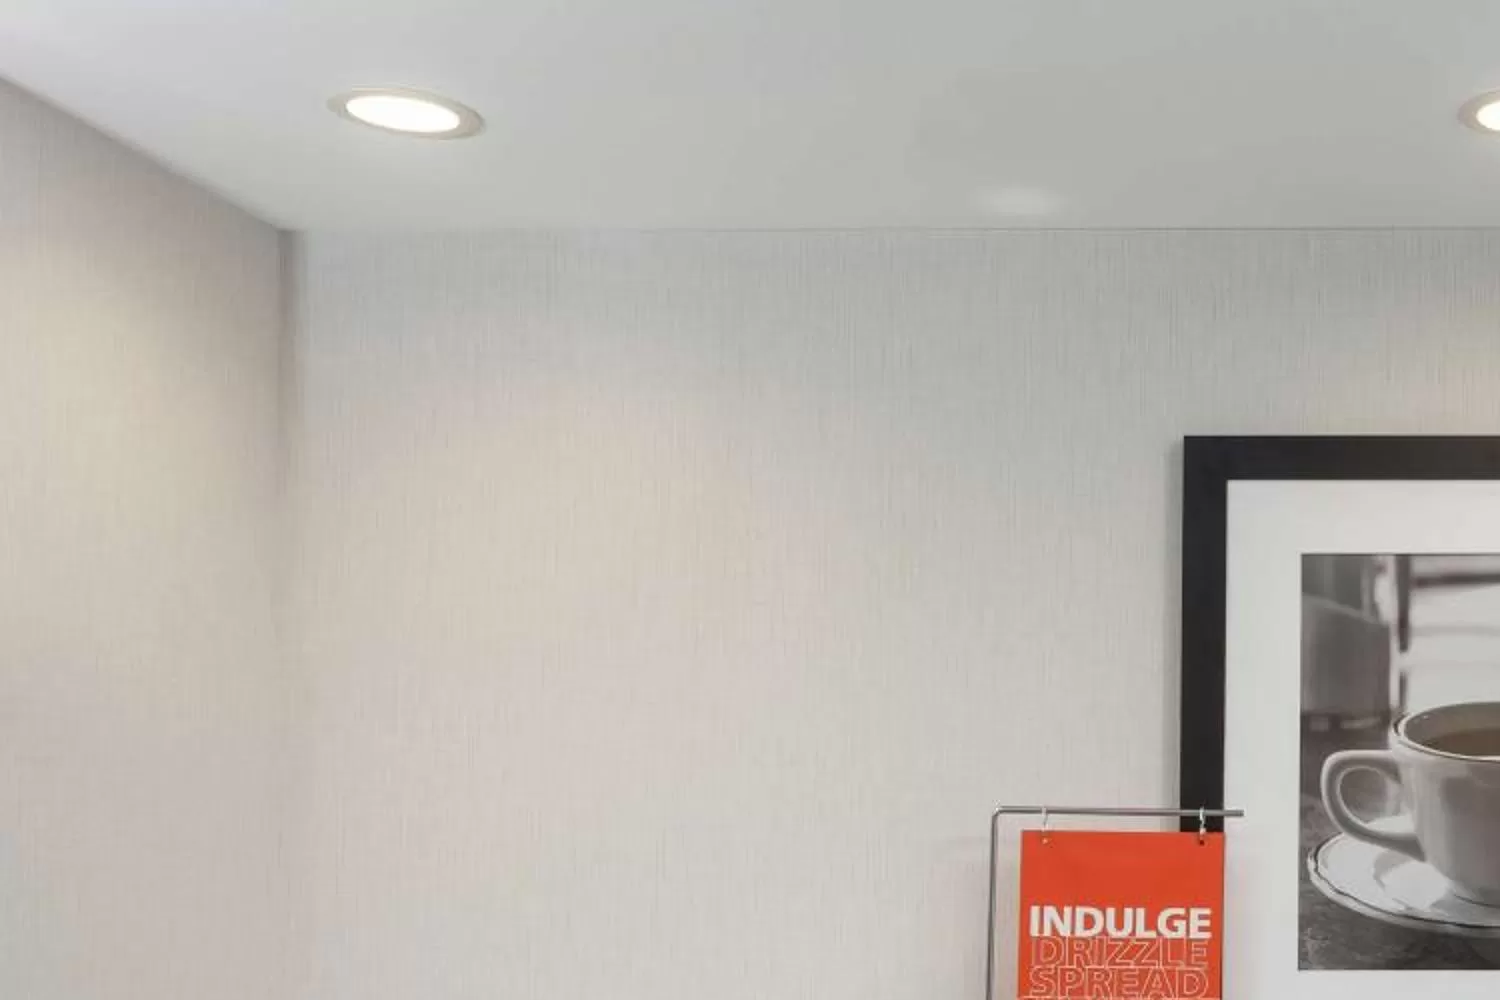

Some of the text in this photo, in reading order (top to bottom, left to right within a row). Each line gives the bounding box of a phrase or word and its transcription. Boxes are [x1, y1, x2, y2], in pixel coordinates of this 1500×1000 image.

[1029, 905, 1212, 939] INDULGE
[1031, 936, 1208, 968] DRIZZLE
[1028, 965, 1208, 999] SPREAD
